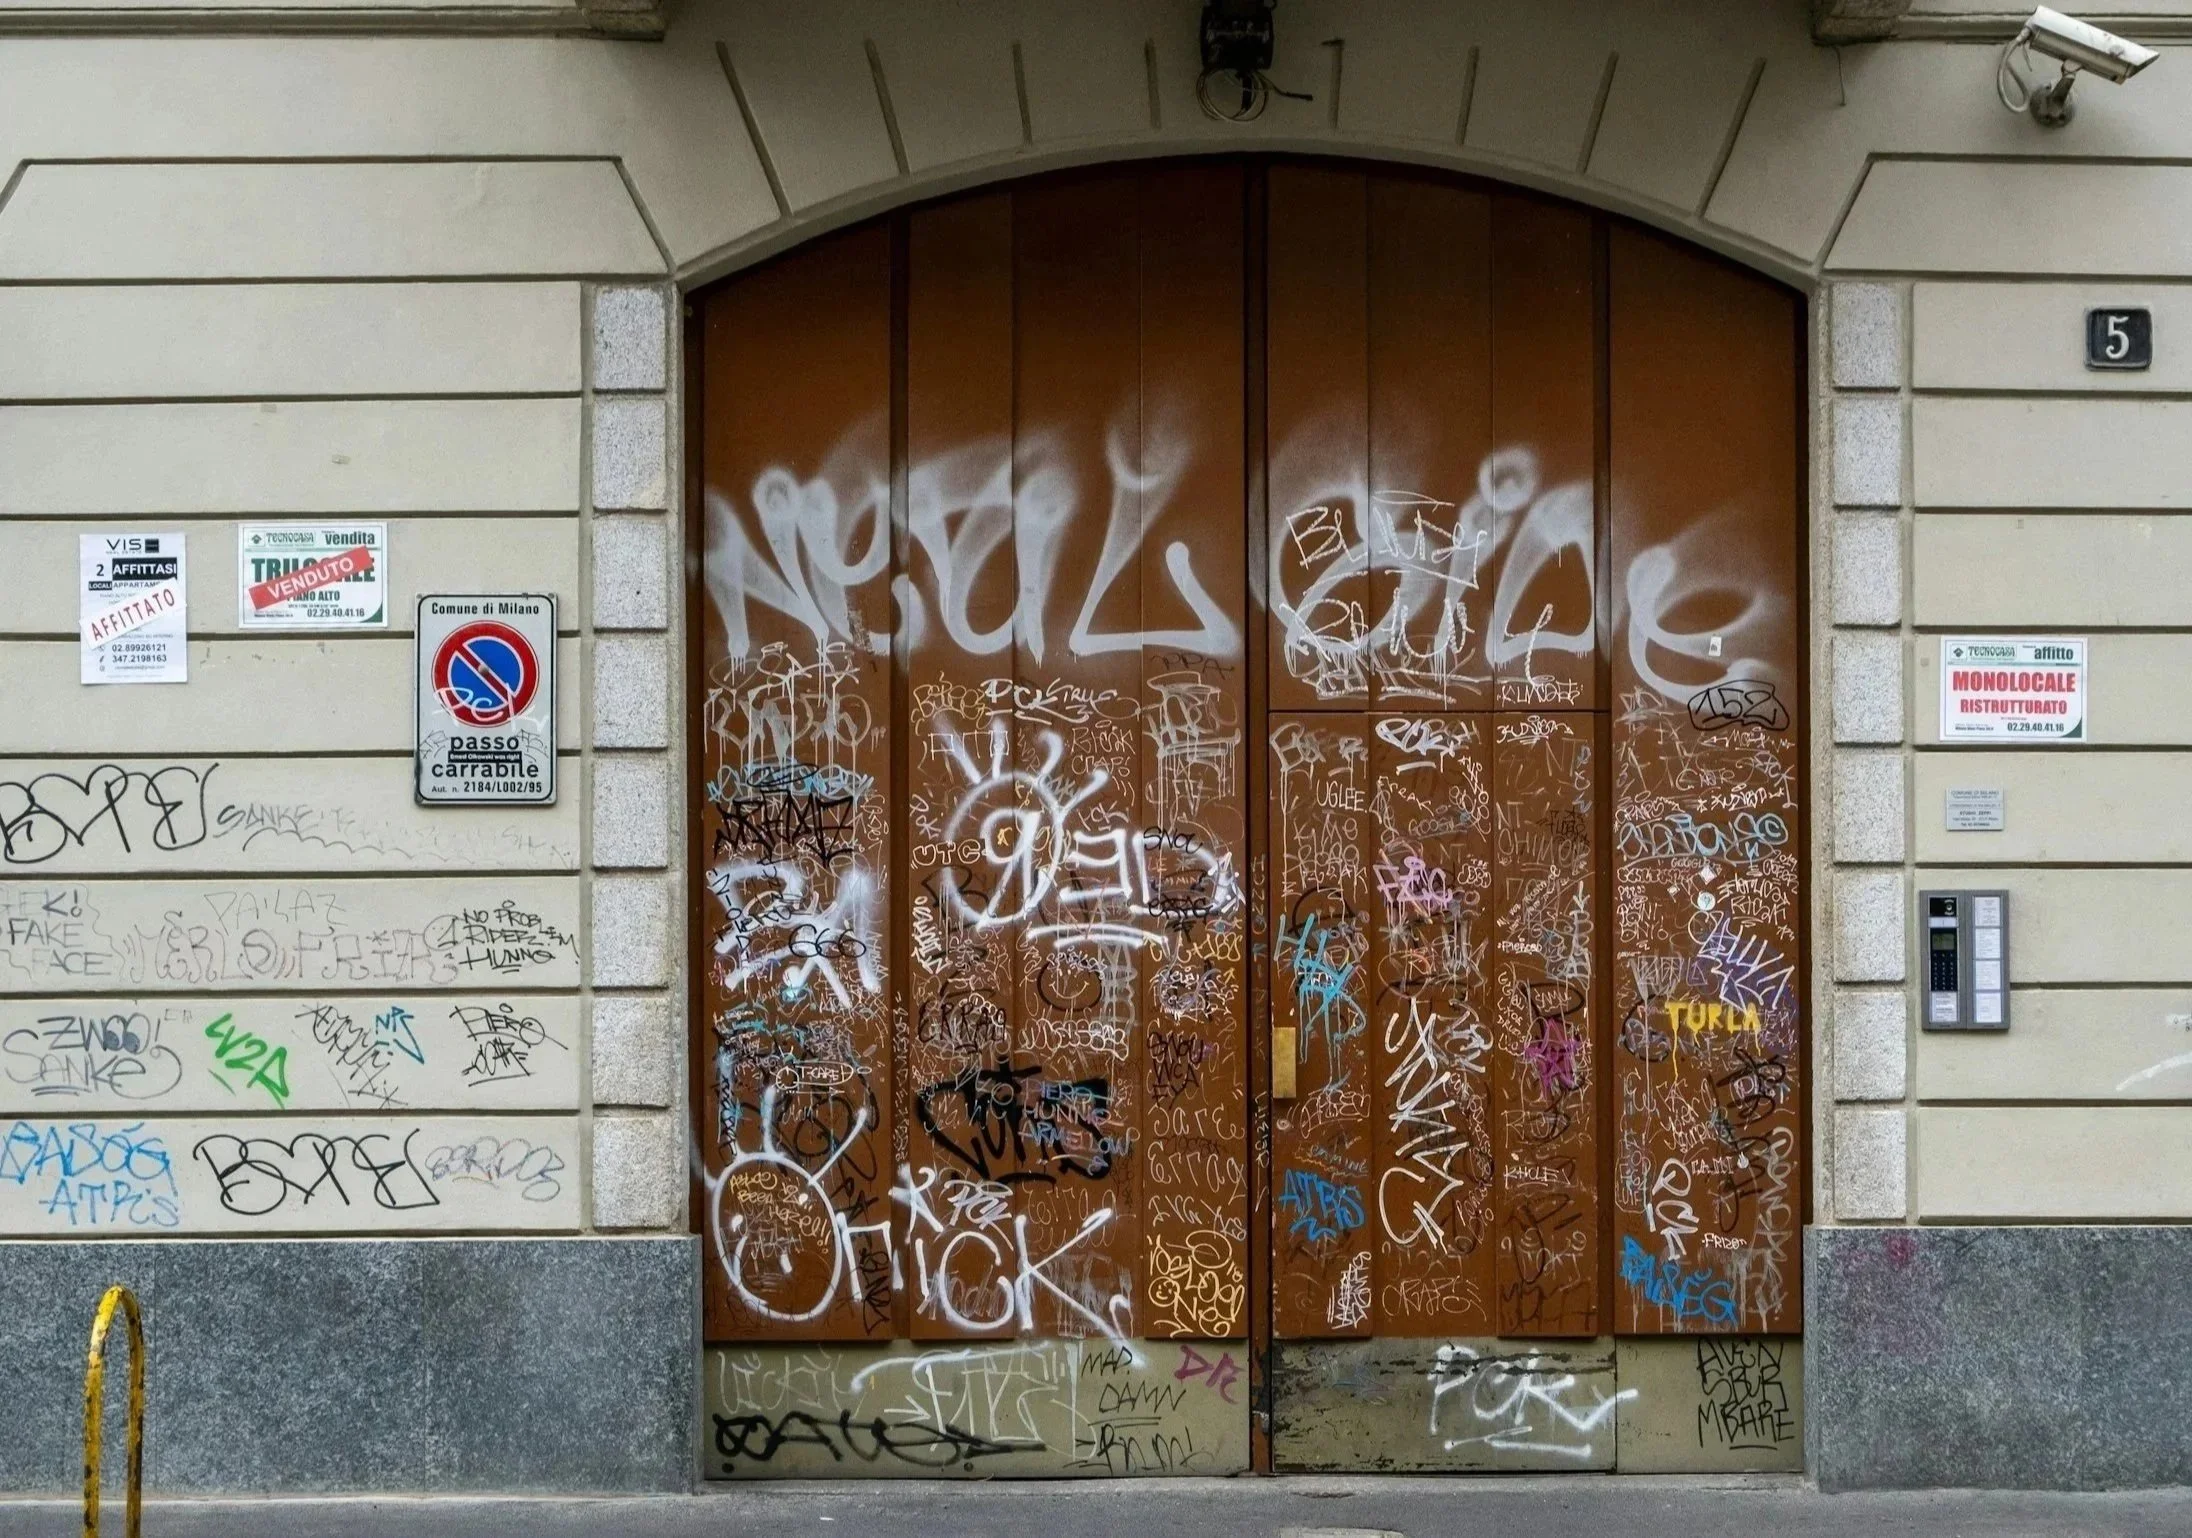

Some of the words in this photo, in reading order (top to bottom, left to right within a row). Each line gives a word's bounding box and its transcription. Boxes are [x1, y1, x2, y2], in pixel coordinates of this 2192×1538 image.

[2106, 316, 2129, 359] 5
[107, 538, 142, 551] VIS
[266, 532, 314, 543] TECNOCASA
[325, 531, 375, 545] vendita
[96, 564, 104, 577] 2
[113, 563, 177, 575] AFFITTASI
[88, 581, 112, 590] LOCALI
[267, 557, 353, 599] VENDUTO
[318, 591, 340, 601] ALTO
[91, 589, 175, 641] AFFITTATO
[432, 602, 478, 614] Comune
[483, 602, 494, 614] di
[499, 602, 539, 614] Milano
[1968, 646, 2015, 657] TECNOCASA
[2034, 646, 2074, 660] affitto
[1952, 670, 2076, 692] MONOLOCALE
[1696, 687, 1778, 726] 152
[1960, 699, 2068, 715] RISTRUTTURATO
[450, 736, 519, 751] passo
[431, 762, 539, 778] carrabile
[463, 781, 542, 793] 2184/L002/95
[464, 908, 489, 924] NO
[7, 917, 84, 948] FAKE
[789, 924, 867, 958] 666
[1665, 1001, 1763, 1035] TURLA
